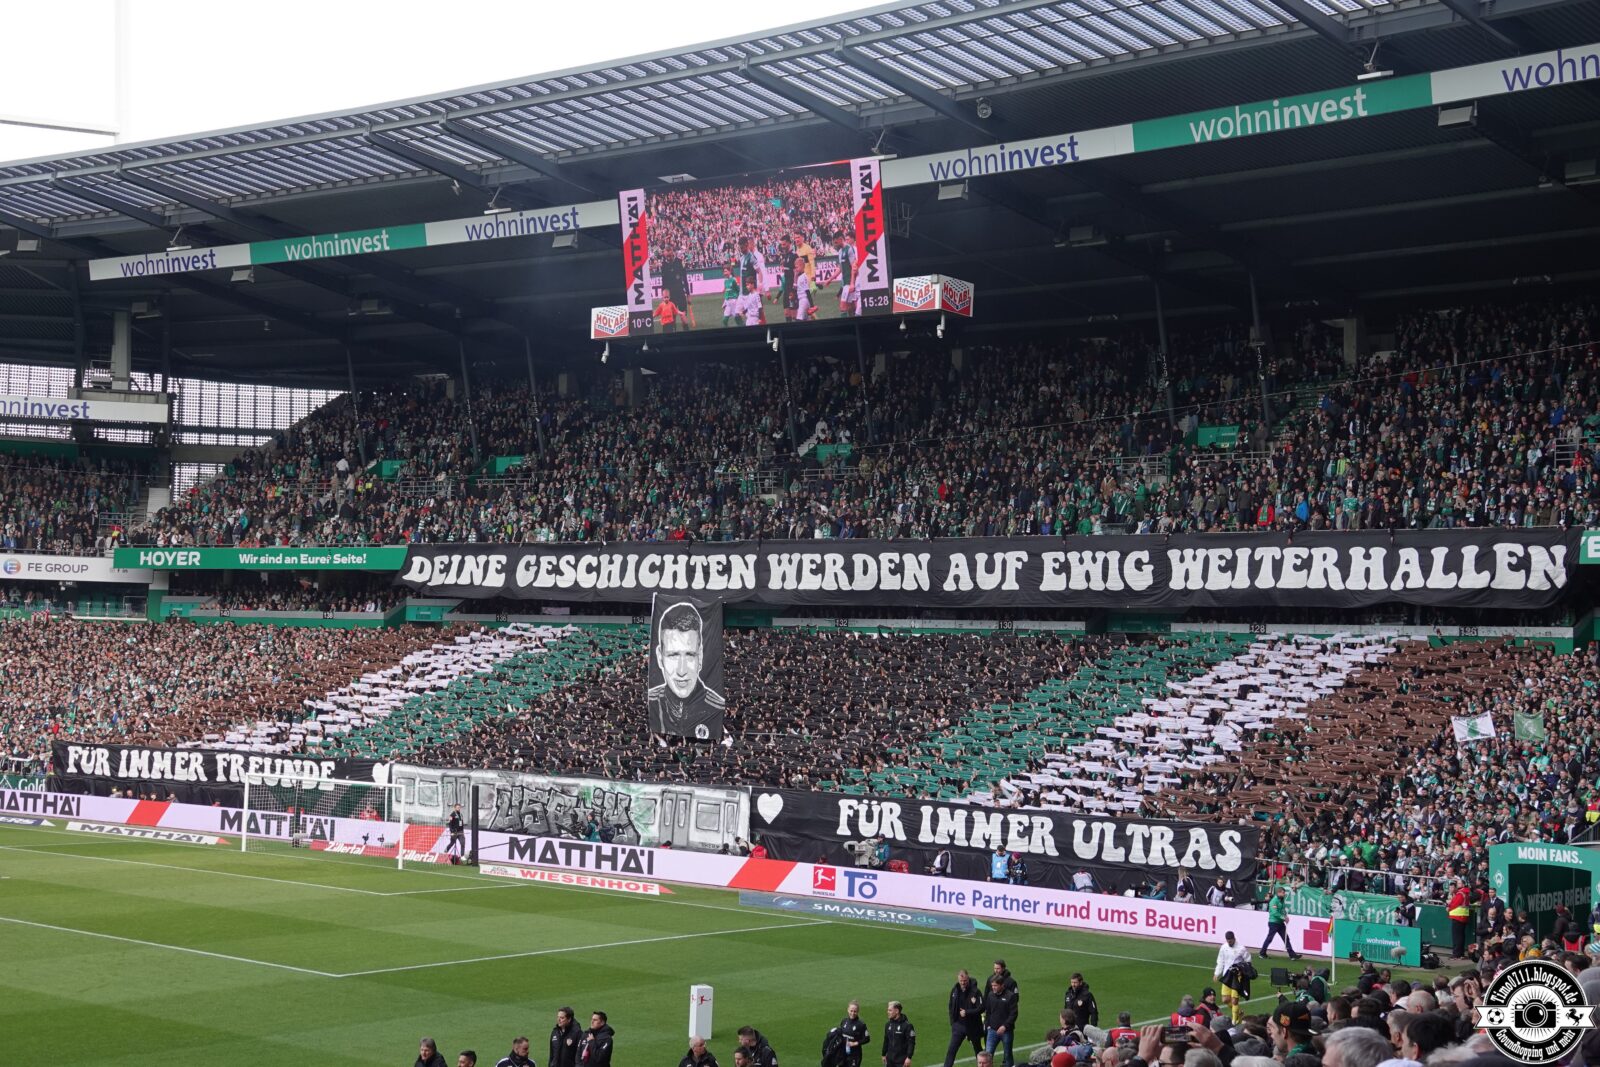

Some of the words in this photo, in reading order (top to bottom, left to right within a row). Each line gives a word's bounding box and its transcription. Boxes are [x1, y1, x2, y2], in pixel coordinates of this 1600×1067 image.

[1189, 87, 1367, 143] wohninvest
[929, 135, 1079, 181] wohninvest
[465, 206, 579, 241] wohninvest
[859, 164, 880, 282] MATTHÄI
[285, 229, 389, 261] wohninvest
[627, 196, 645, 305] MATTHÄI
[121, 249, 216, 277] wohninvest
[863, 295, 889, 308] 15:28
[632, 317, 652, 329] 10°C
[27, 562, 42, 572] FE
[45, 563, 89, 574] GROUP
[140, 551, 201, 566] HOYER
[239, 554, 258, 564] Wir
[259, 553, 283, 564] sind
[284, 555, 298, 564] an
[333, 553, 367, 564] Seite!
[402, 554, 506, 587] DEINE
[516, 554, 757, 591] GESCHICHTEN
[767, 552, 930, 592] WERDEN
[943, 550, 1028, 592] AUF
[1039, 549, 1154, 592] EWIG
[1167, 544, 1567, 591] WEITERHALLEN
[836, 619, 848, 627] 132
[999, 621, 1012, 629] 130
[66, 745, 111, 777] FÜR
[117, 749, 208, 782] IMMER
[216, 753, 335, 791] FREUNDE
[80, 823, 205, 843] MATTHÄI
[220, 809, 336, 842] MATTHÄI
[836, 799, 906, 841] FÜR
[917, 805, 1059, 856] IMMER
[1072, 819, 1242, 872] ULTRAS
[324, 841, 366, 855] Zillertal
[396, 849, 439, 863] Zillertal
[508, 837, 655, 876] MATTHÄI
[1518, 846, 1548, 860] MOIN
[1549, 848, 1583, 864] FANS.
[520, 869, 655, 893] WIESENHOF
[931, 885, 966, 905] Ihre
[972, 890, 1040, 914] Partner
[1046, 899, 1091, 920] rund
[1097, 906, 1138, 925] ums
[1145, 908, 1217, 935] Bauen!
[1527, 890, 1564, 912] WERDER
[1565, 886, 1592, 907] BREME
[812, 903, 938, 924] SMAVESTO.de
[1366, 937, 1401, 947] wohninvest
